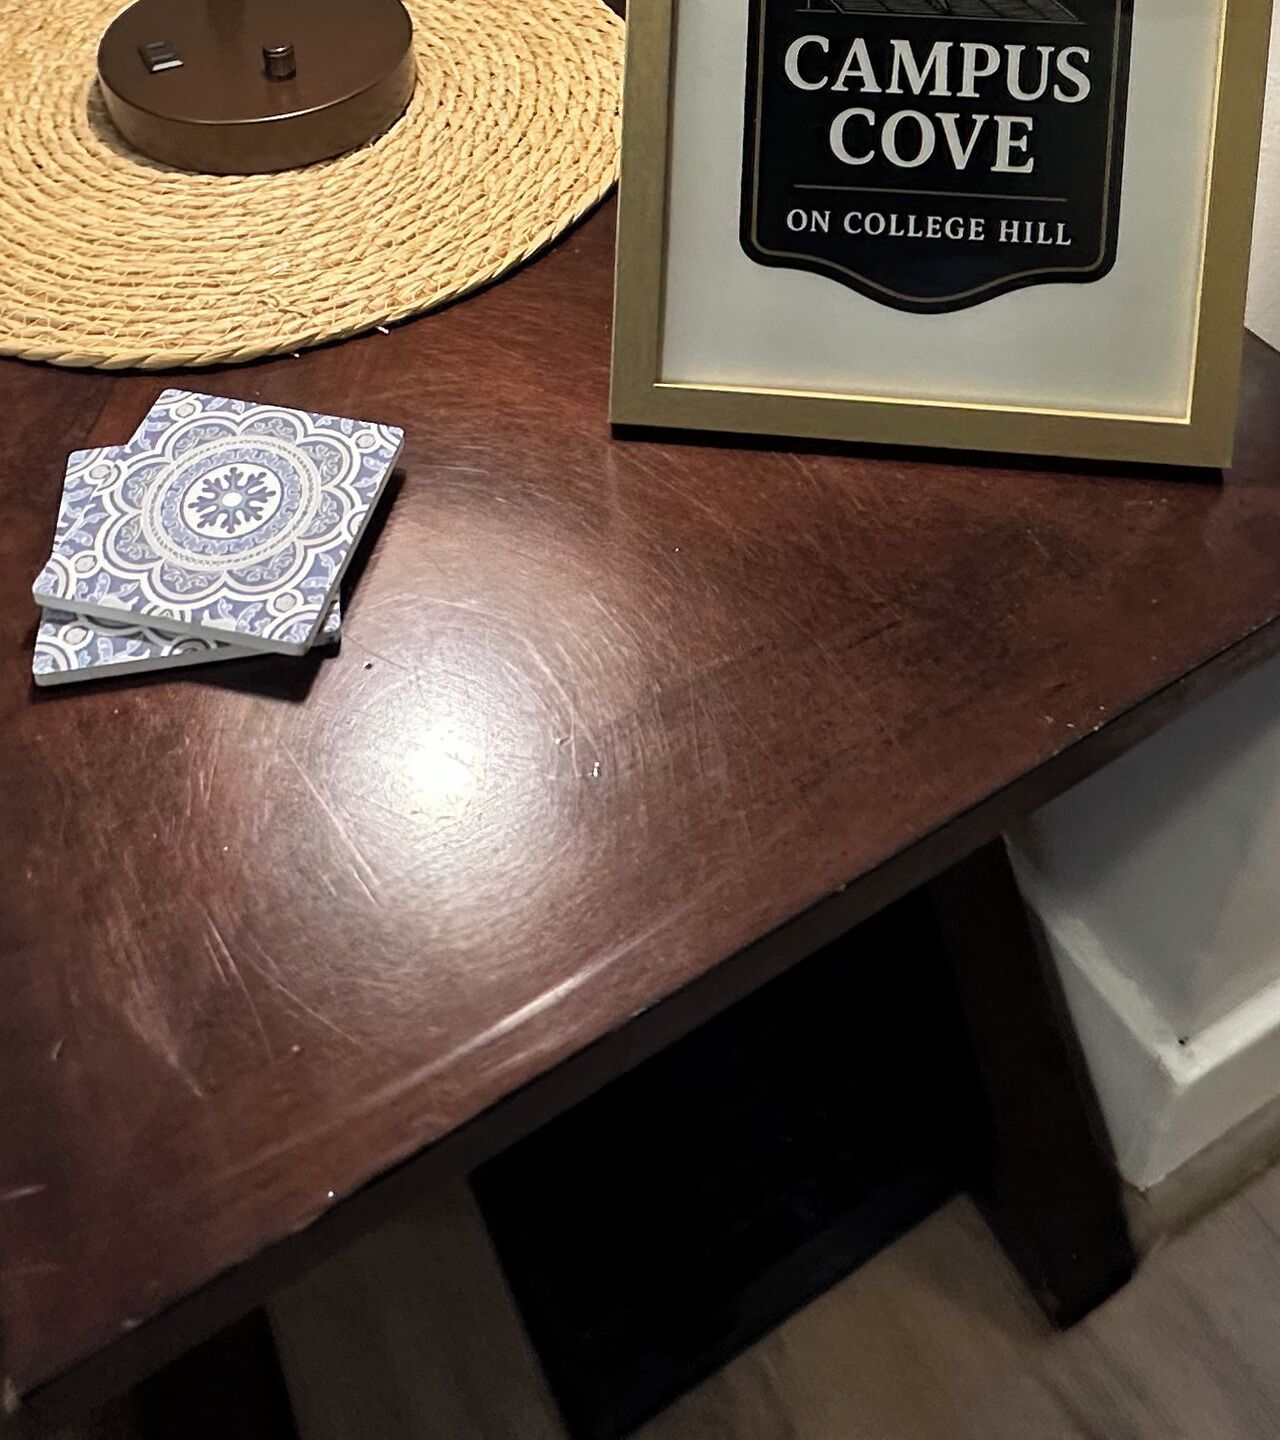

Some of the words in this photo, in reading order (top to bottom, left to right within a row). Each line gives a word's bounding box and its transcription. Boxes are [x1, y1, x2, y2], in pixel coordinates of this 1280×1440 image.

[784, 34, 1092, 103] CAMPUS
[829, 108, 1035, 174] COVE
[786, 208, 831, 236] ON
[843, 212, 985, 241] COLLEGE
[998, 220, 1072, 247] HILL
